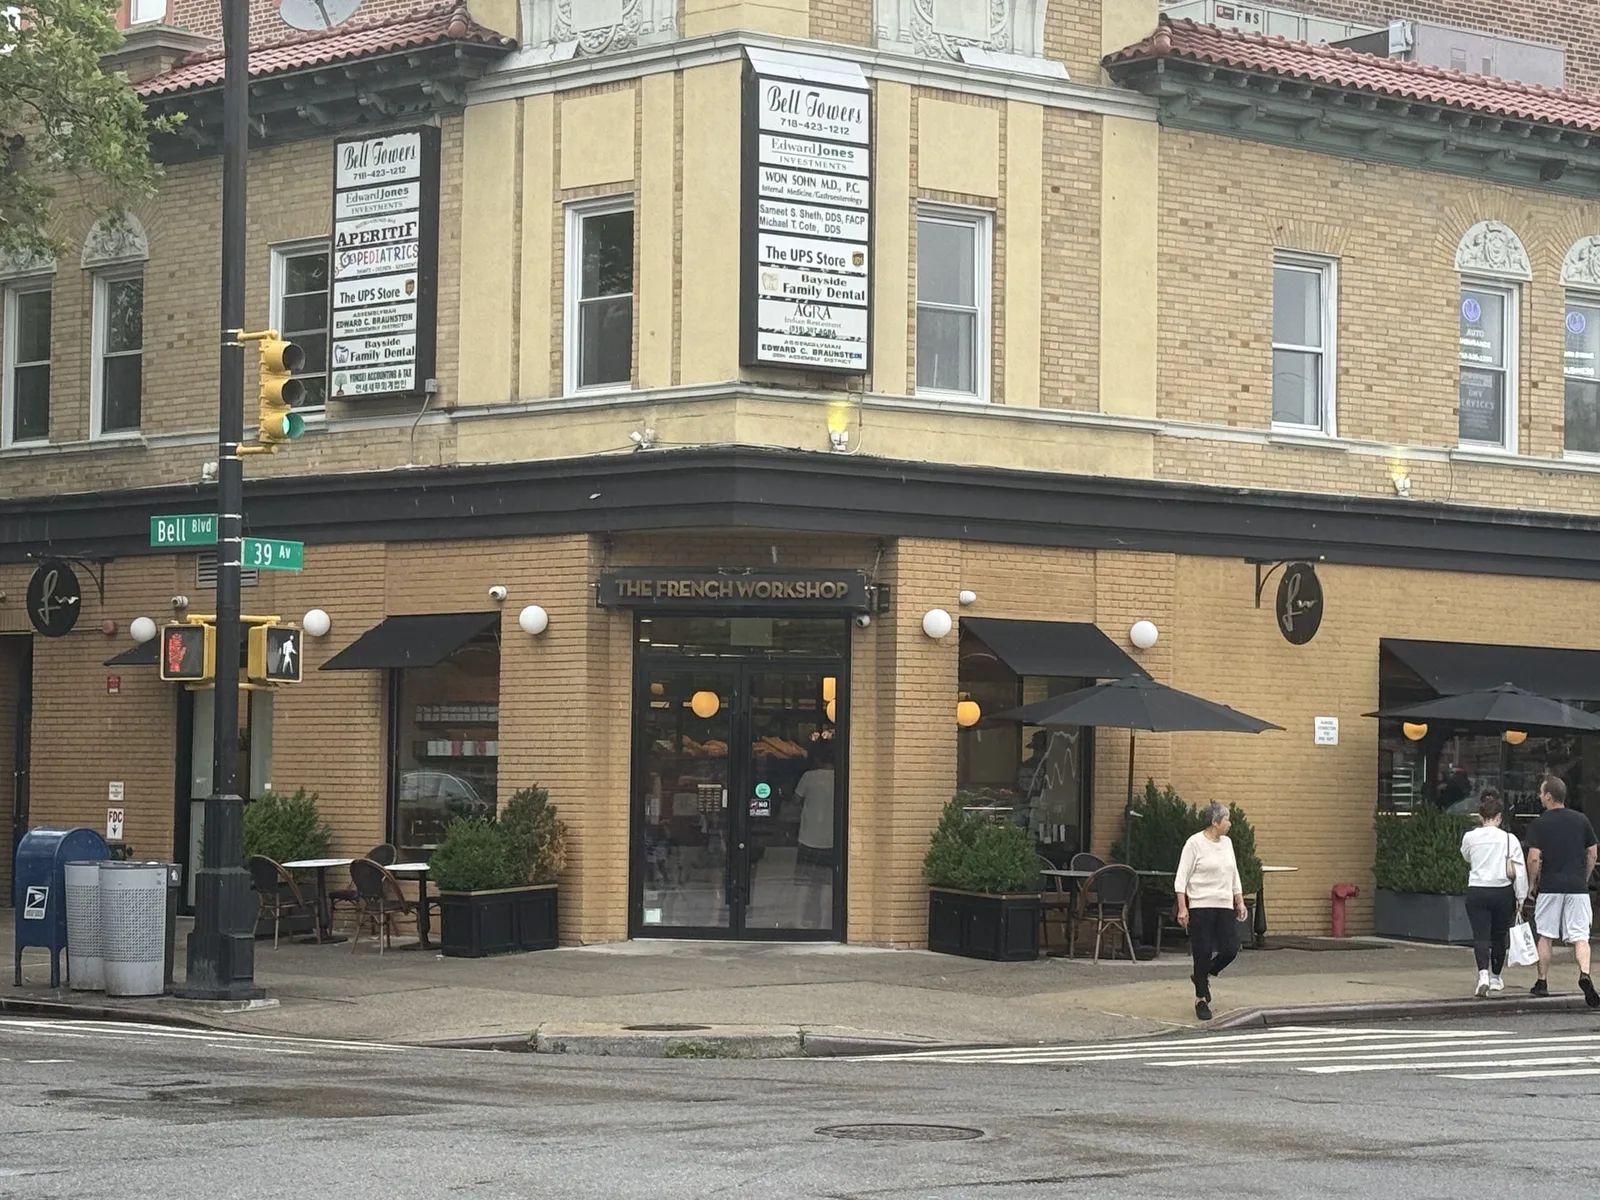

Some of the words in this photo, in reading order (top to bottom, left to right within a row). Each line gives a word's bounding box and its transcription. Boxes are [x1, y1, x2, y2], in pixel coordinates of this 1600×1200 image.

[767, 85, 801, 115] Bell
[805, 91, 862, 124] Towers
[780, 117, 850, 136] 718-423-1212
[343, 142, 369, 170] Bell
[372, 141, 416, 166] Towers
[779, 155, 847, 171] INVESTMENTS
[353, 166, 407, 180] 718-423-1212
[761, 184, 784, 194] Internal
[765, 171, 788, 184] WON
[792, 174, 816, 188] SOHN
[846, 181, 860, 194] P.C.
[351, 201, 403, 214] INVESTMENTS
[760, 204, 788, 217] Sameet
[790, 208, 798, 217] S.
[799, 209, 823, 222] Sheth,
[825, 212, 844, 225] DDS,
[845, 214, 865, 226] FACP
[760, 216, 788, 229] Michael
[791, 219, 798, 229] T.
[799, 221, 819, 234] Cote,
[824, 224, 841, 235] DDS
[335, 221, 417, 248] APERITIF
[357, 243, 419, 266] PEDIATRICS
[765, 245, 787, 260] The
[790, 248, 813, 264] UPS
[816, 251, 846, 267] Store
[801, 274, 847, 287] Bayside
[340, 292, 356, 304] The
[357, 288, 375, 302] UPS
[377, 287, 401, 300] Store
[783, 282, 822, 299] Family
[826, 287, 865, 301] Dental
[335, 318, 362, 329] EDWARD
[364, 318, 371, 326] C.
[372, 313, 413, 325] BRAUNSTEIN
[352, 308, 397, 318] ASSEMBLYMAN
[794, 304, 832, 321] AGRA
[364, 338, 401, 349] Bayside
[761, 343, 797, 354] EDWARD
[800, 347, 808, 355] C.
[812, 348, 863, 360] BRAUNSTEIN
[783, 339, 842, 350] ASSEMBLYMAN
[350, 349, 381, 362] Family
[384, 346, 415, 359] Dental
[1459, 398, 1495, 410] ERVICES
[157, 518, 186, 542] Bell
[191, 518, 212, 533] Blvd
[254, 542, 272, 566] 39
[278, 545, 291, 559] Av
[615, 579, 652, 597] THE
[656, 579, 733, 598] FRENCH
[737, 580, 849, 599] WORKSHOP
[108, 810, 123, 824] FDC
